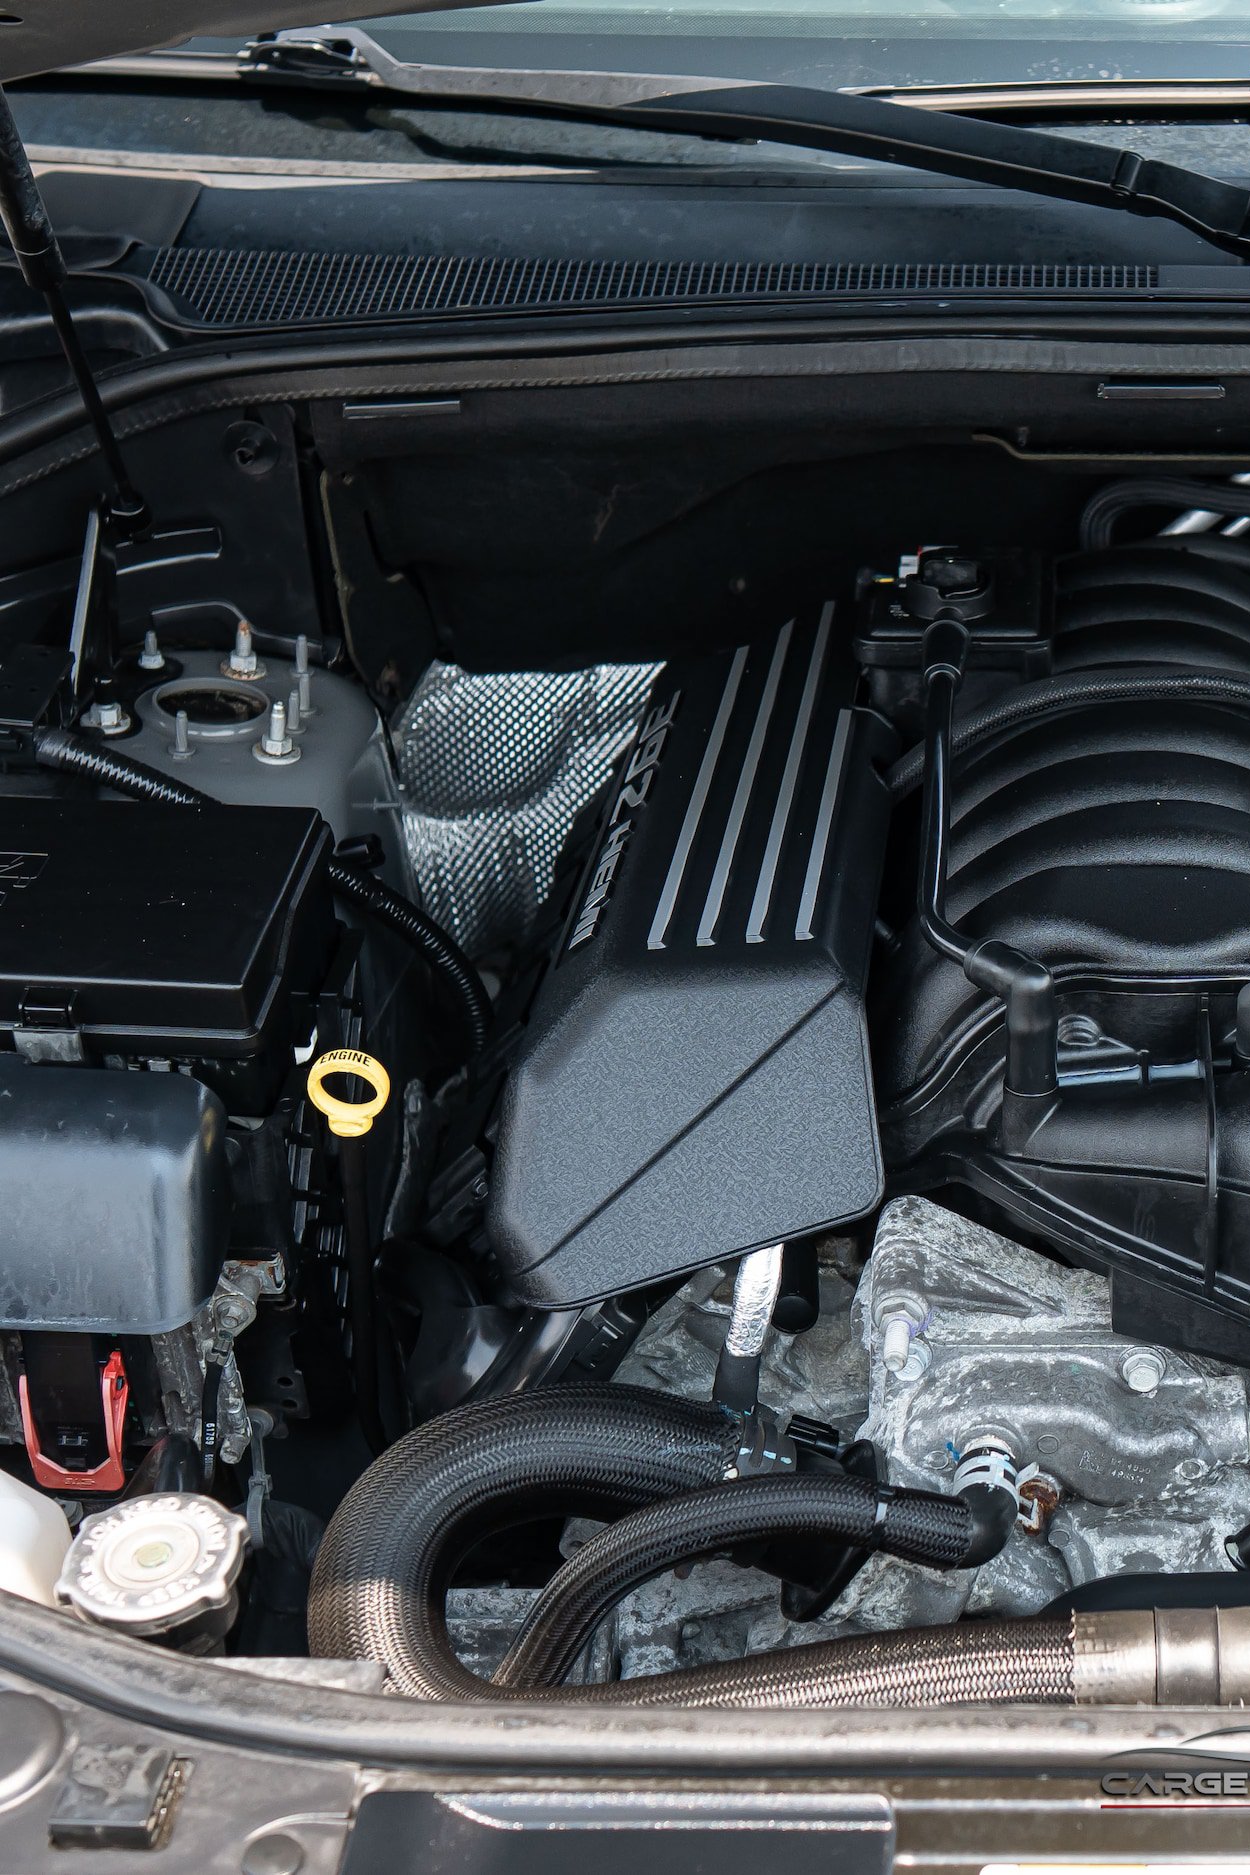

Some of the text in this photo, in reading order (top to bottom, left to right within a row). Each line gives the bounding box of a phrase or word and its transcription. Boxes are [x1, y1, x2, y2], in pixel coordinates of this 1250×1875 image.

[568, 690, 681, 950] 392 HEMI
[320, 1050, 372, 1067] ENGINE
